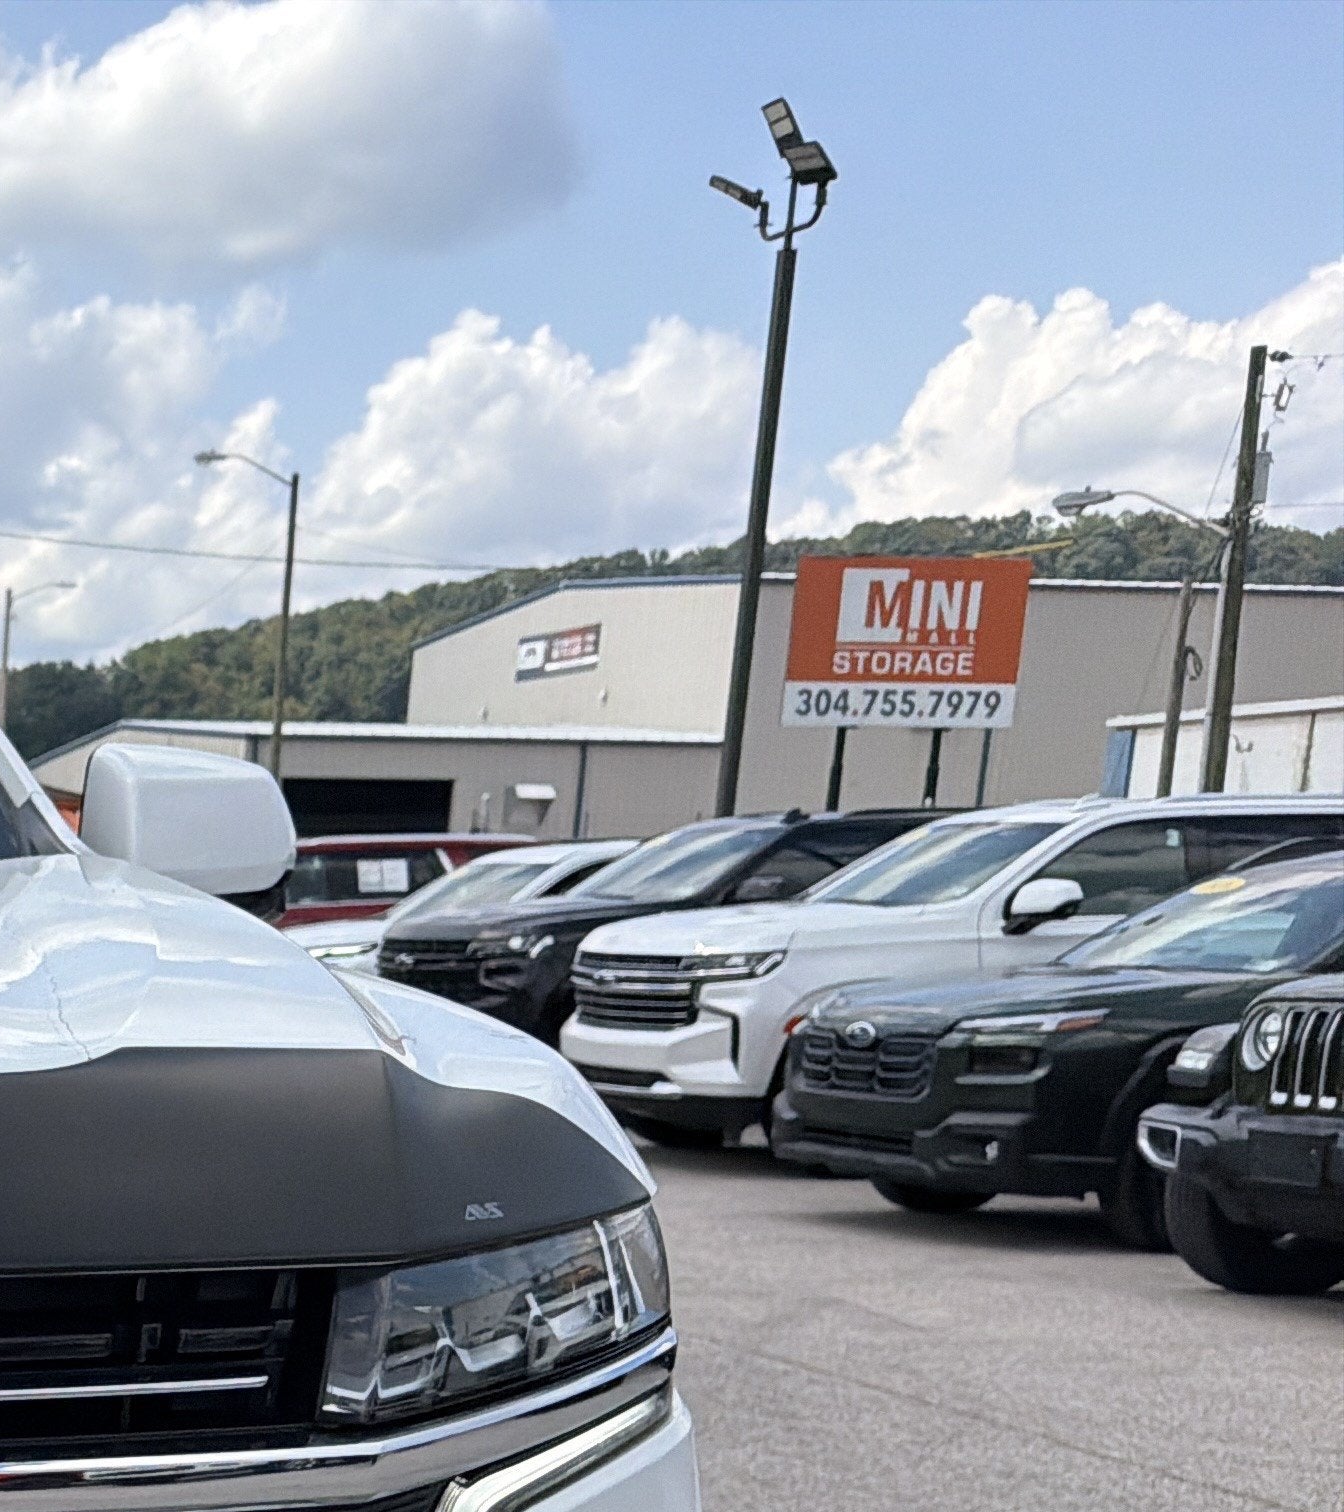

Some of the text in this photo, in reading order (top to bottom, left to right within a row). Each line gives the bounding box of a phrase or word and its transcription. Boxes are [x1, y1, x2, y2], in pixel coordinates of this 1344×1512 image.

[864, 579, 984, 632] MINI
[832, 650, 974, 677] STORAGE
[794, 688, 1002, 719] 304.755.7979
